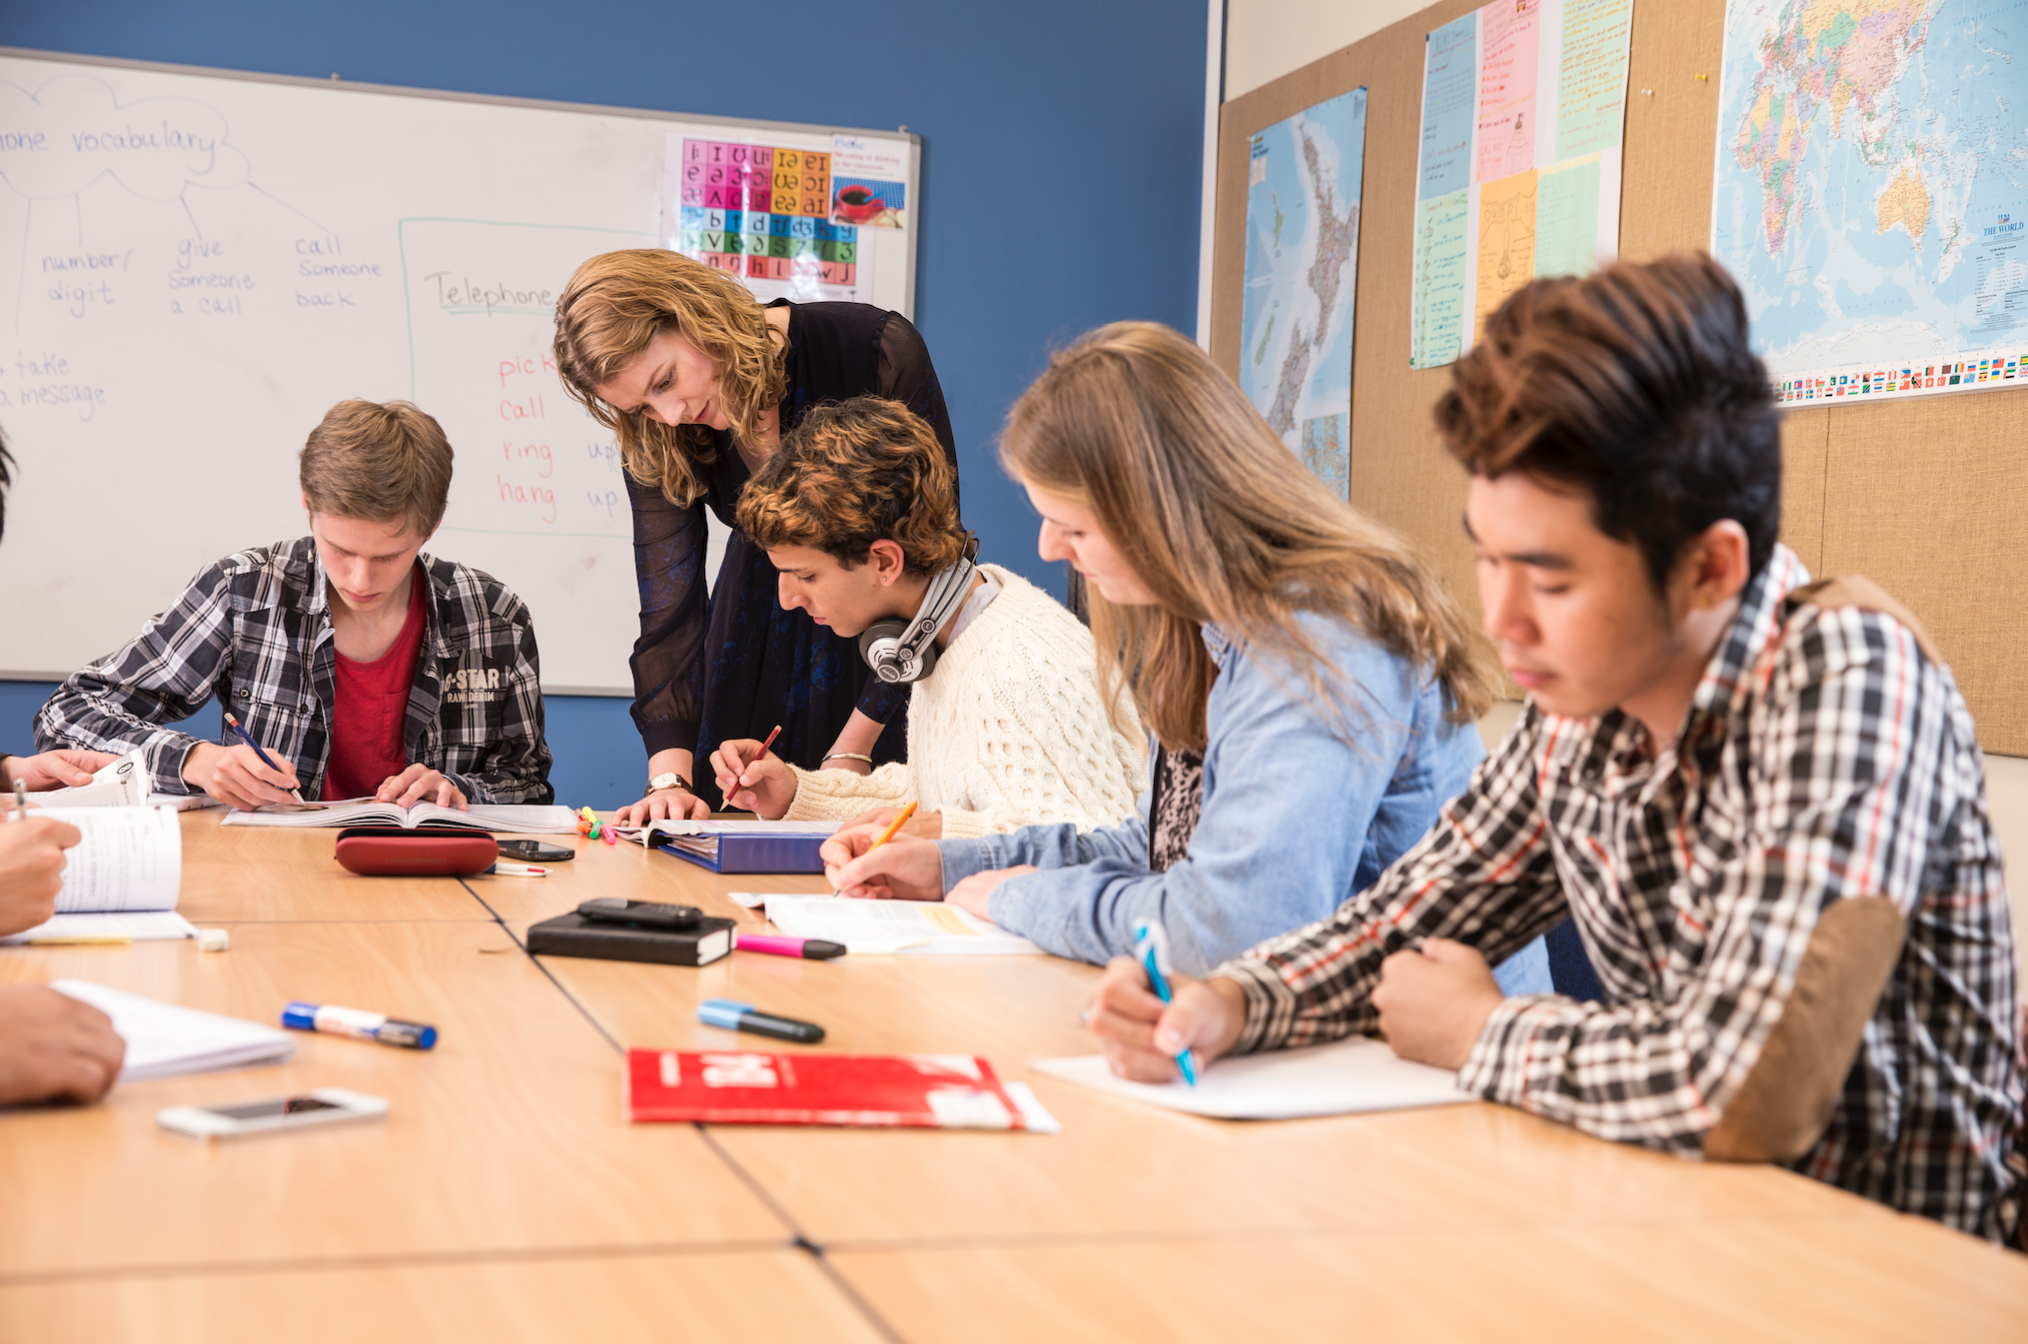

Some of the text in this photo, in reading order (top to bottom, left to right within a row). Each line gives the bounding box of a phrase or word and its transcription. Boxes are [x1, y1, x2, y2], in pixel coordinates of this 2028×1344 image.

[72, 119, 216, 176] vocabulary
[295, 233, 343, 258] call
[1983, 226, 1998, 237] THE
[1998, 221, 2025, 234] WORLD
[178, 238, 226, 271] give
[47, 279, 116, 320] digit
[170, 296, 242, 317] a call
[296, 290, 357, 309] back
[424, 270, 551, 317] Telephone
[14, 349, 72, 380] take
[498, 352, 558, 389] pick
[20, 383, 107, 424] message
[502, 440, 617, 480] ring up
[496, 472, 618, 525] hang up
[444, 667, 500, 693] G-STAR
[447, 691, 495, 704] RAW DENIM
